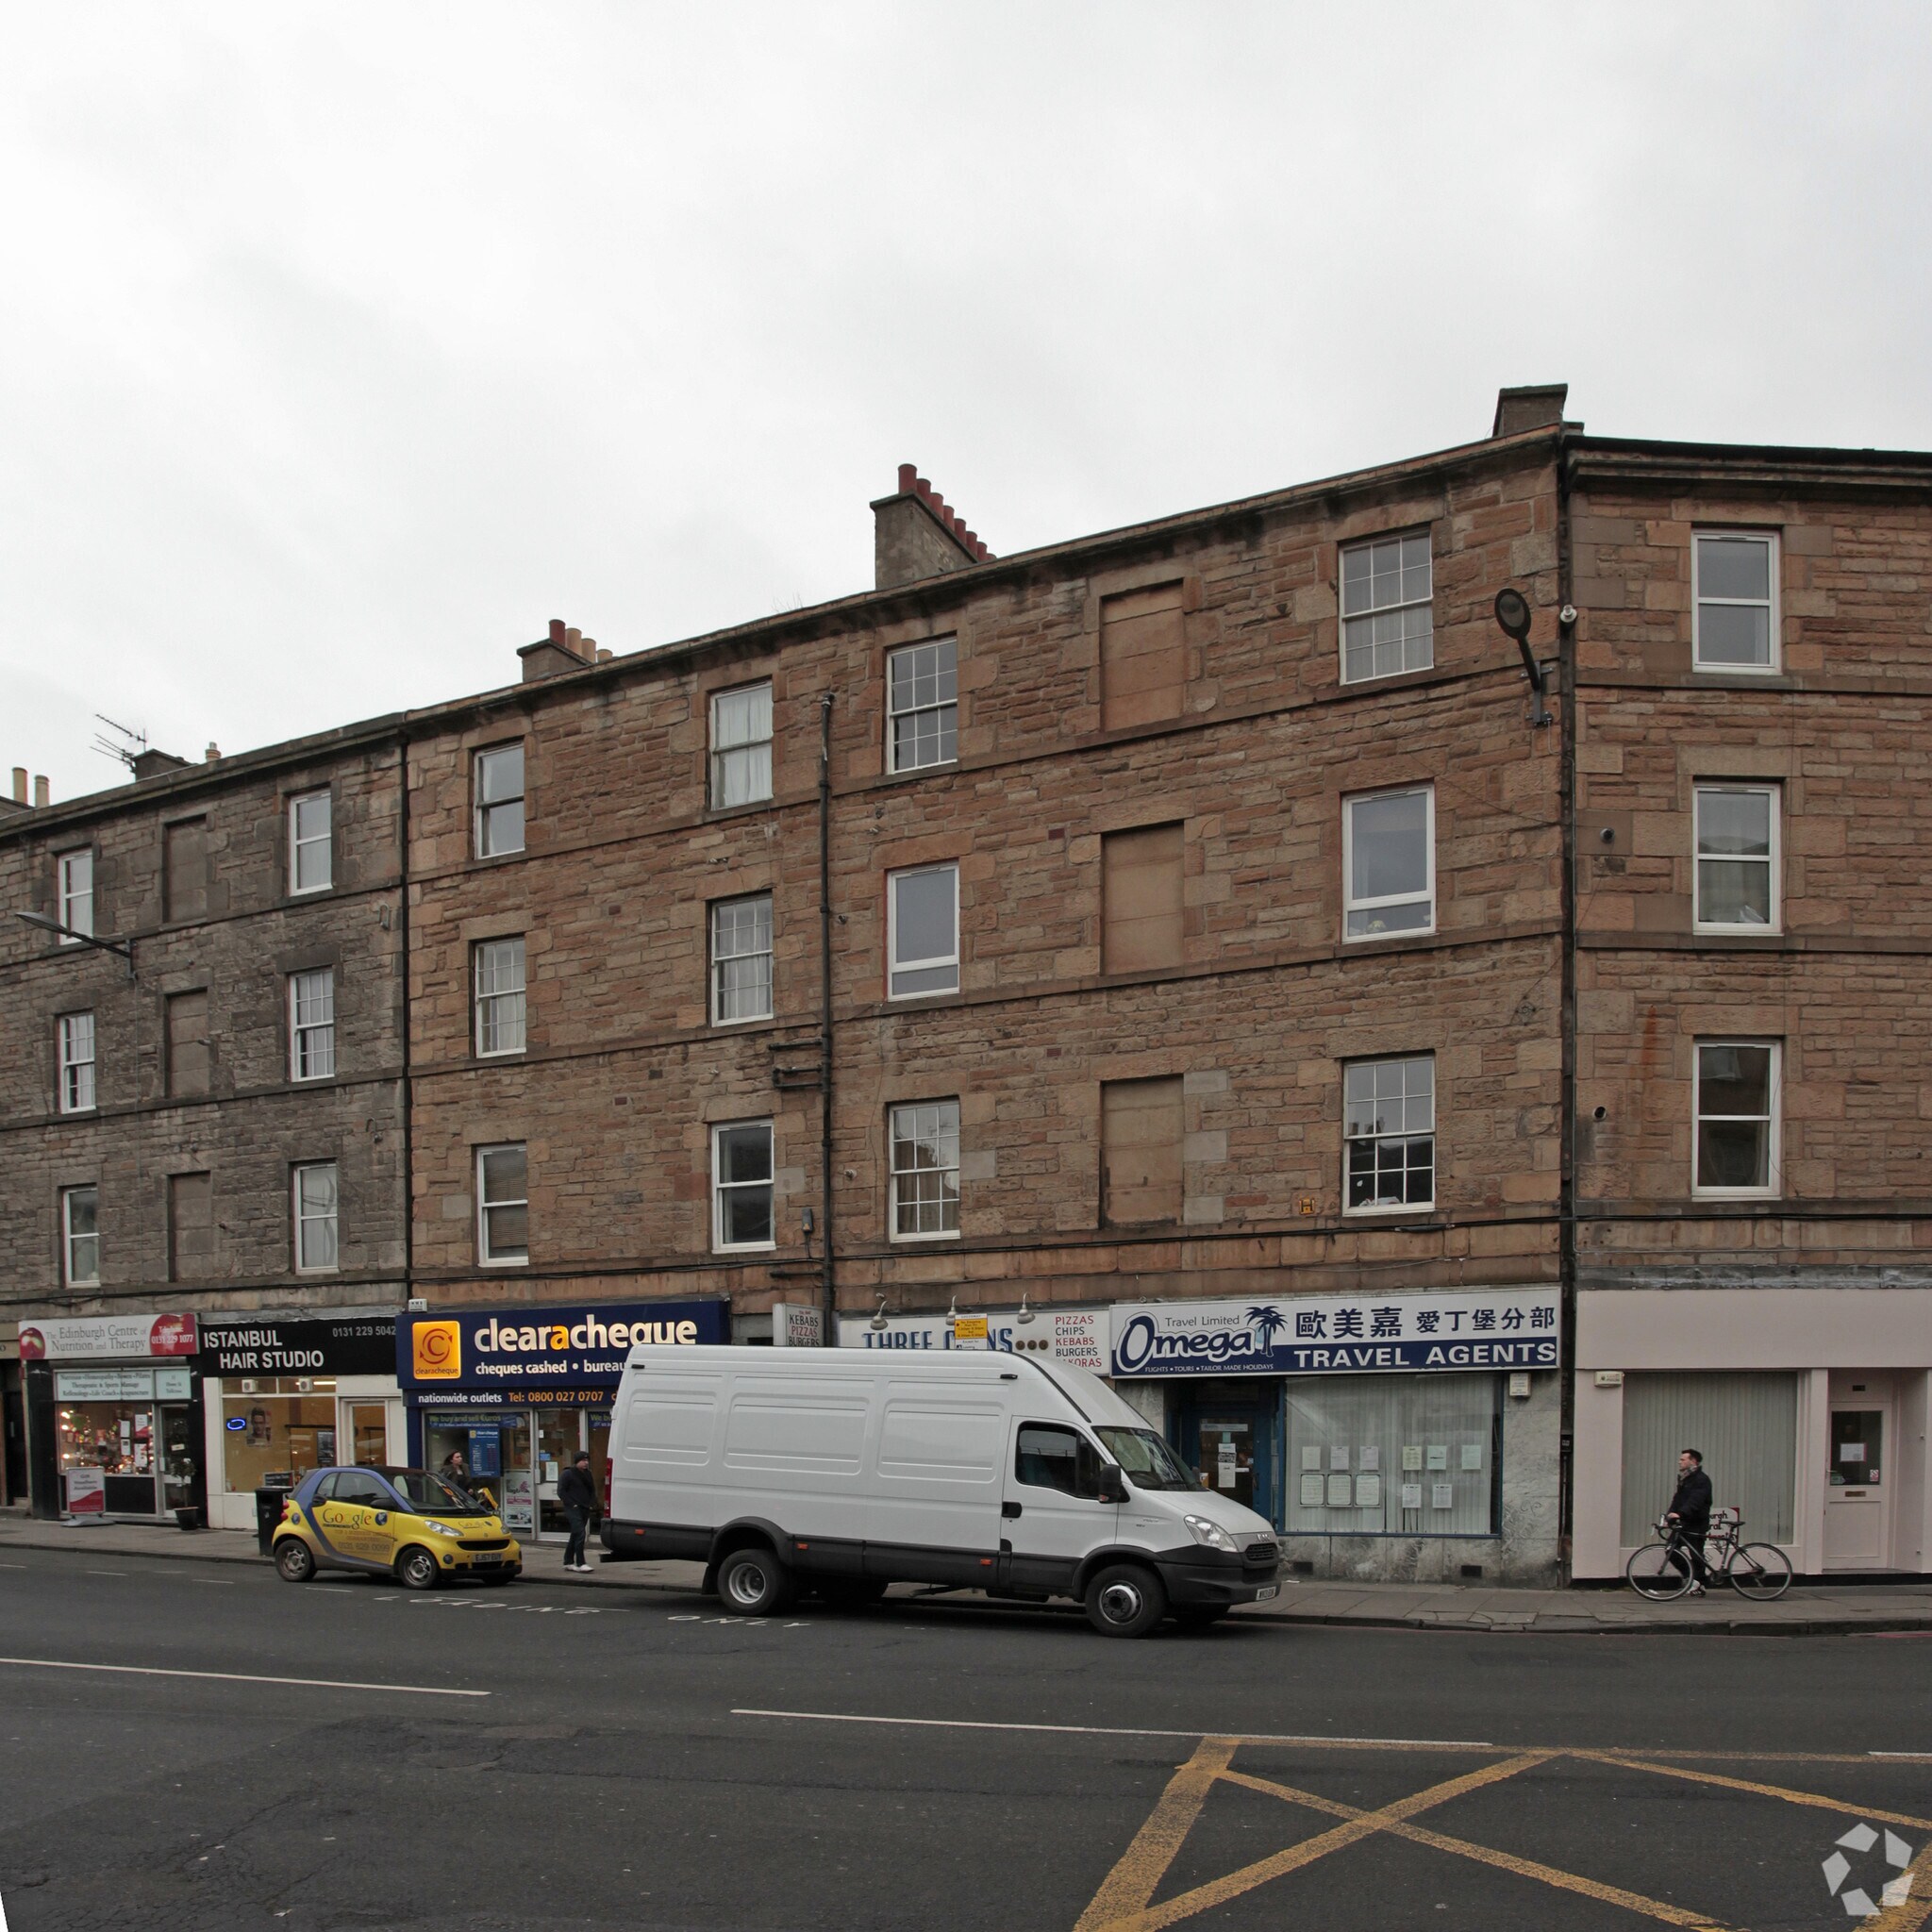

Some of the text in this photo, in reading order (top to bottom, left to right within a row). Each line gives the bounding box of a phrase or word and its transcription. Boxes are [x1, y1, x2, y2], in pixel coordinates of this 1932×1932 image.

[789, 1314, 819, 1327] KEBABS
[1055, 1315, 1094, 1325] PIZZAS
[1164, 1315, 1241, 1327] Travel Limited
[1295, 1306, 1556, 1340] 歐美嘉 愛丁堡分部
[58, 1324, 106, 1341] Edinburgh
[108, 1324, 138, 1337] Centre
[332, 1324, 397, 1338] 0131 229 5042
[475, 1313, 697, 1353] clearacheque
[791, 1325, 818, 1338] PIZZAS
[1055, 1326, 1085, 1336] CHIPS
[51, 1337, 146, 1352] Nutrition and Therapy
[203, 1329, 283, 1349] ISTANBUL
[788, 1336, 820, 1346] BURGERS
[862, 1330, 933, 1349] THREE
[1056, 1337, 1095, 1346] KEBABS
[1120, 1315, 1252, 1369] Omega
[1056, 1347, 1098, 1357] BURGERS
[1293, 1342, 1557, 1368] TRAVEL AGENTS
[219, 1350, 325, 1369] HAIR STUDIO
[1063, 1357, 1102, 1368] KORAS
[415, 1366, 458, 1376] clearacheque
[475, 1358, 626, 1377] cheques cashed bureau
[418, 1391, 502, 1404] nationwide outlets
[508, 1391, 525, 1402] Tel:
[527, 1391, 554, 1403] 0800
[556, 1391, 575, 1402] 027
[578, 1391, 604, 1402] 0707
[322, 1507, 372, 1530] Gogle
